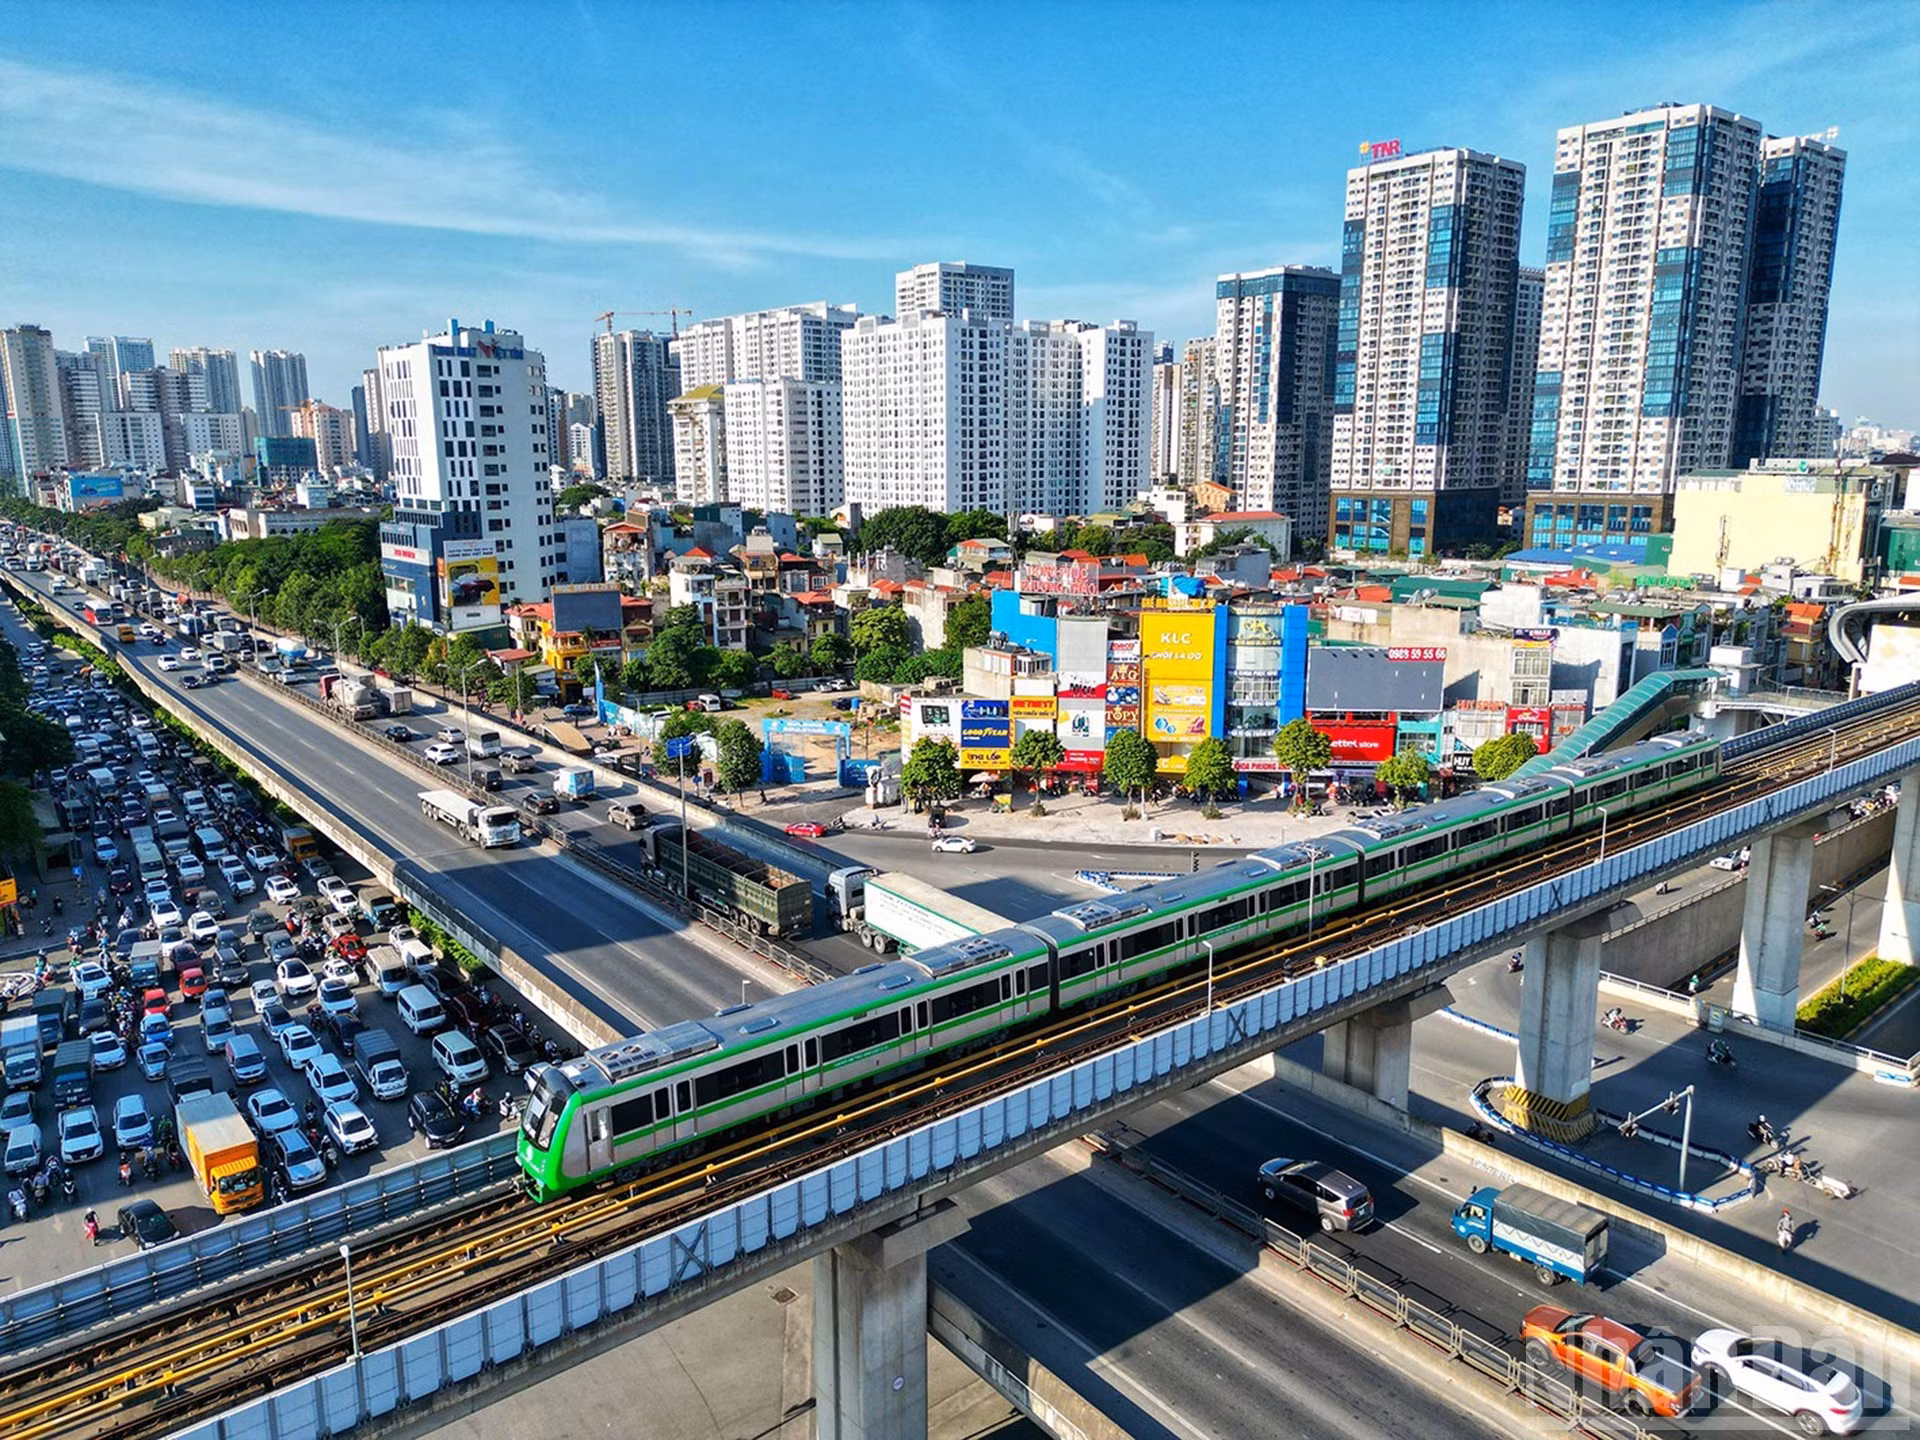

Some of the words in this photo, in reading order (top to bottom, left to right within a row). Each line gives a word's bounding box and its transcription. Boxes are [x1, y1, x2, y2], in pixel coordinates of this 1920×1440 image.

[1371, 140, 1400, 158] TNR
[1161, 632, 1192, 645] KLC
[1106, 710, 1138, 720] TOPY
[963, 727, 1008, 737] GOODYEAR
